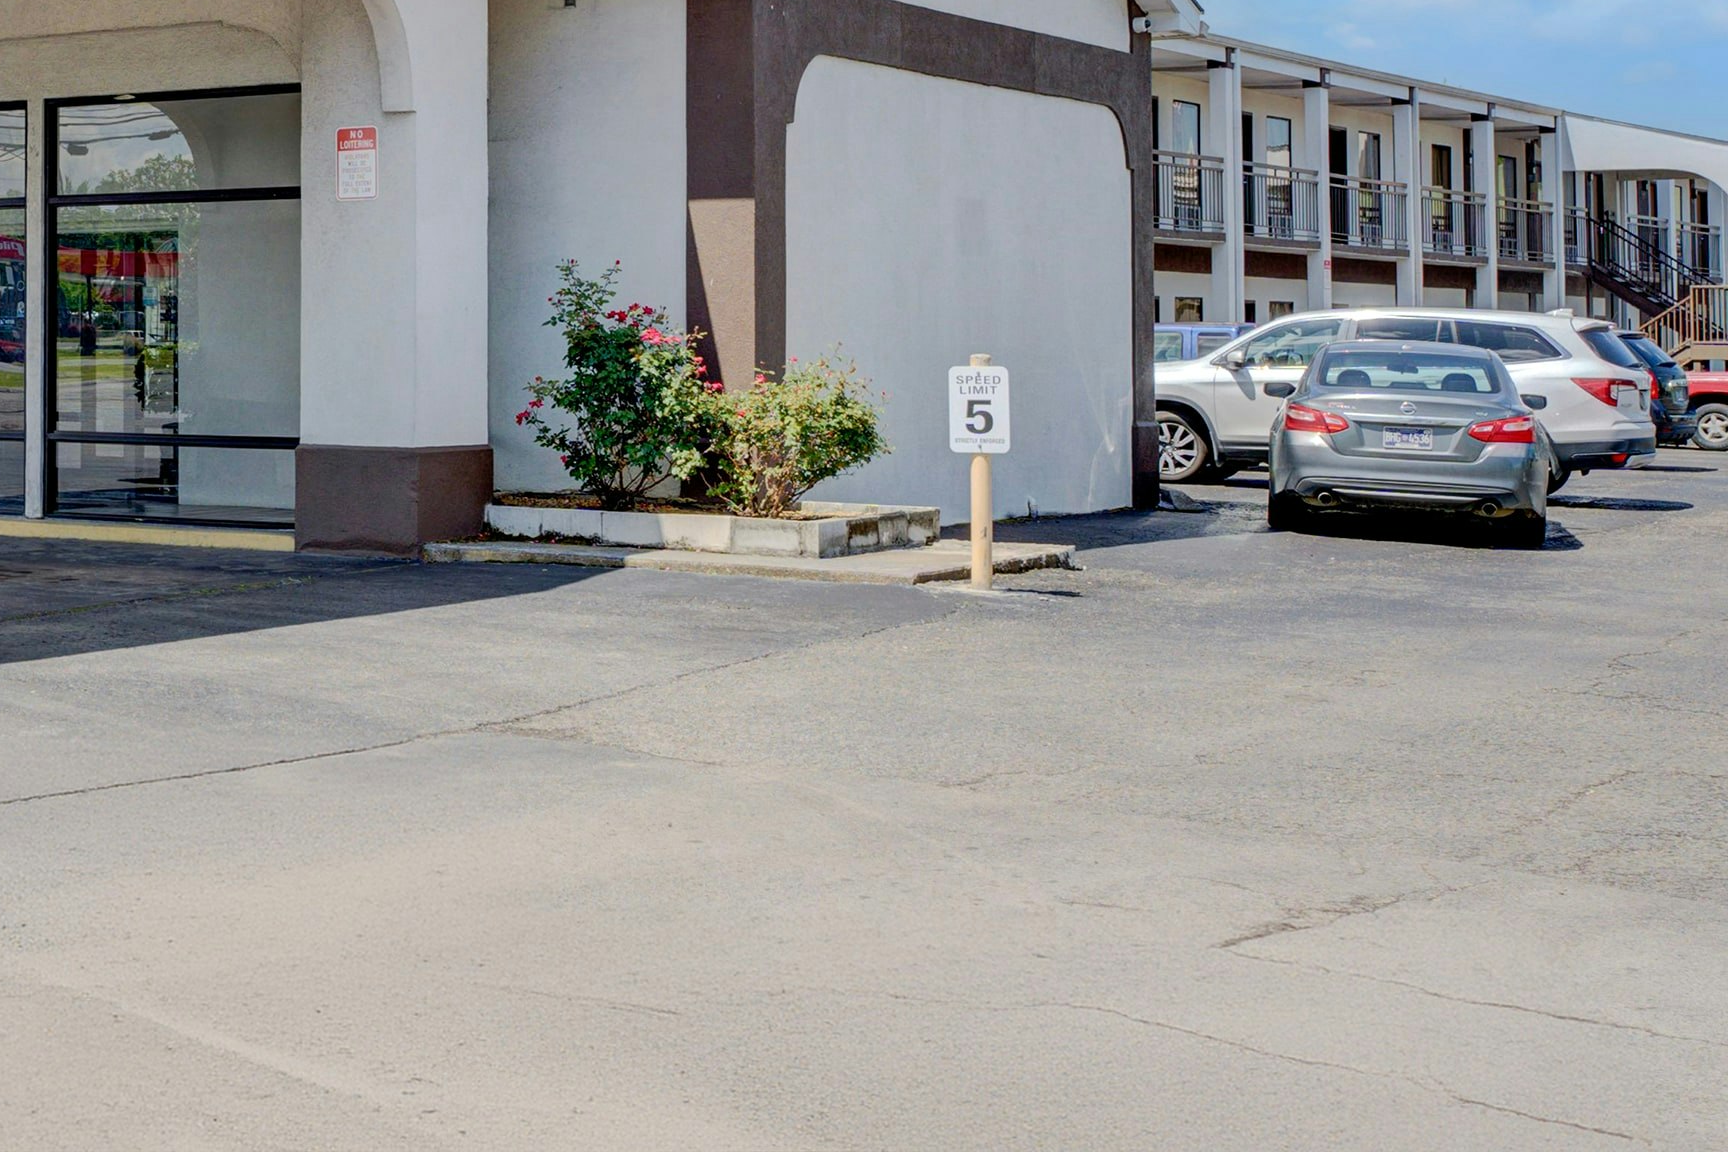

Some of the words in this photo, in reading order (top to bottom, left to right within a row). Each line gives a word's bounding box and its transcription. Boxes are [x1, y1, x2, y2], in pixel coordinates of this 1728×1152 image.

[350, 130, 363, 139] NO
[956, 375, 1001, 385] SPEED
[959, 386, 998, 395] LIMIT
[965, 399, 994, 435] 5
